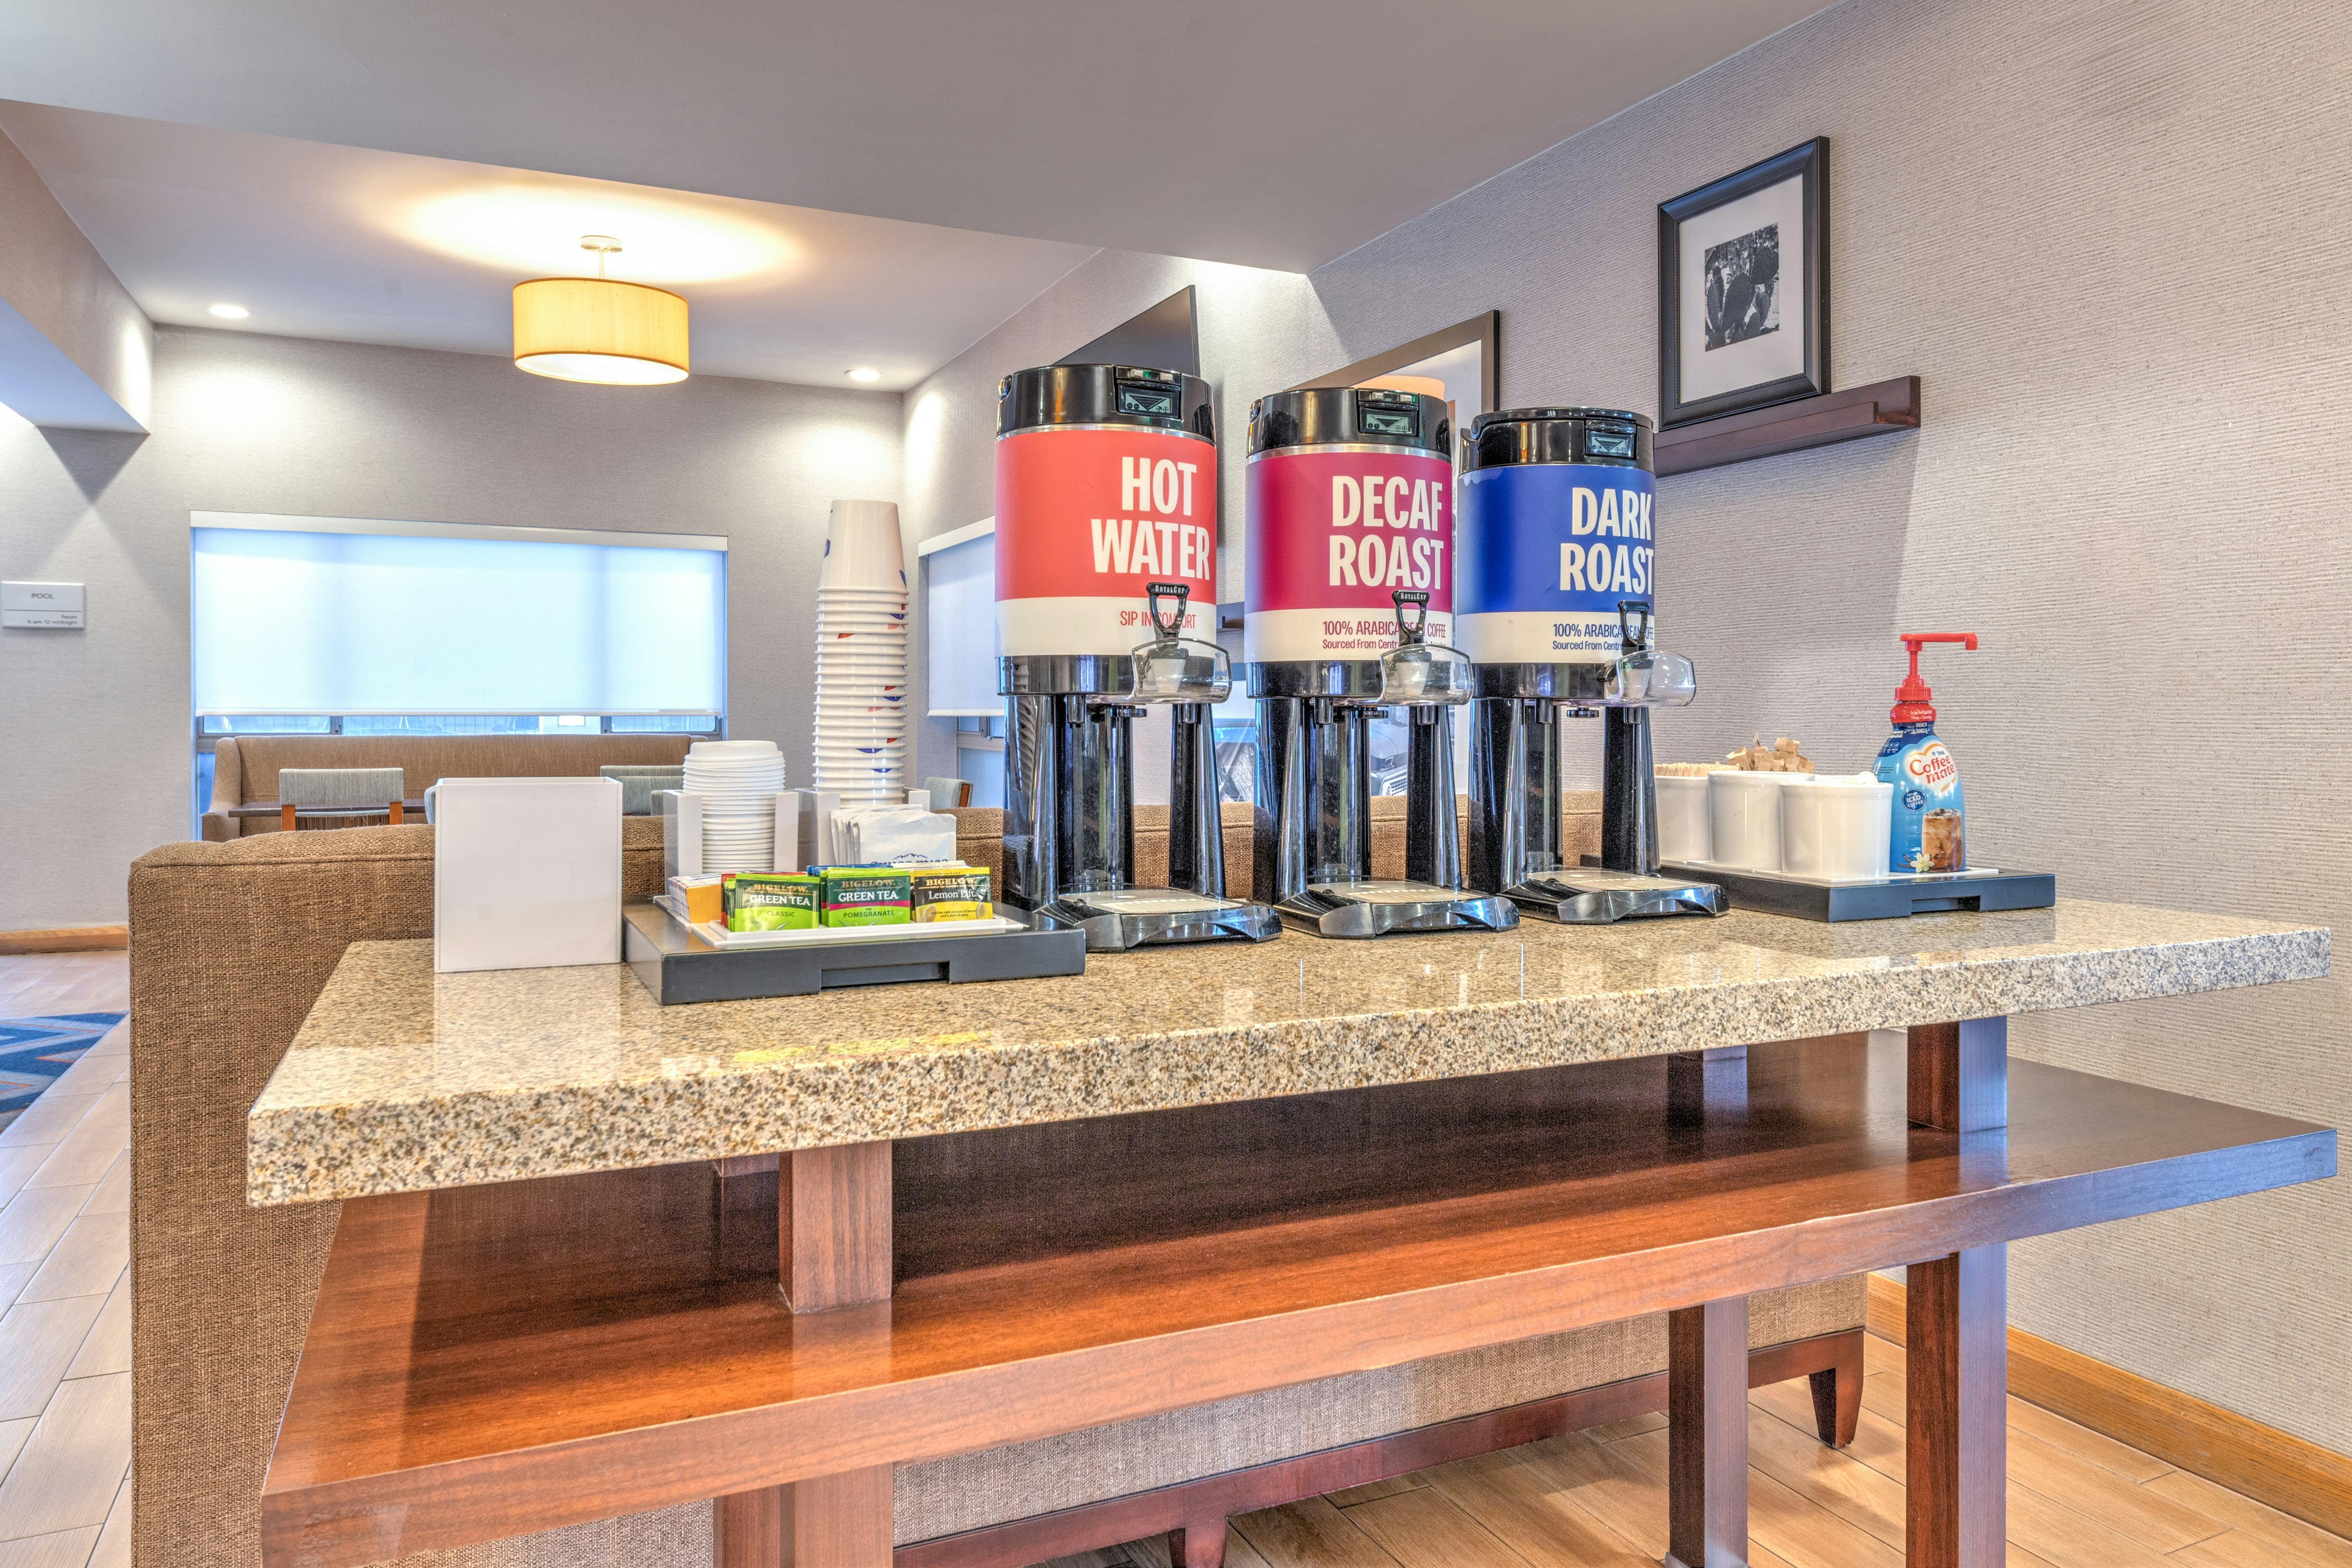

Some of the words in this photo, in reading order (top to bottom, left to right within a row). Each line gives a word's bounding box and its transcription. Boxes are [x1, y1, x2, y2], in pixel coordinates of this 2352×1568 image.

[1122, 456, 1197, 516] HOT
[1332, 475, 1443, 532] DECAF
[1572, 487, 1652, 541] DARK
[1091, 518, 1210, 581] WATER
[1329, 534, 1444, 590] ROAST
[1560, 543, 1655, 595] ROAST
[1120, 610, 1138, 626] SIP
[1142, 611, 1153, 627] IN
[1322, 620, 1354, 636] 100%
[1356, 620, 1400, 636] ARABICA
[1427, 622, 1446, 639] COFFEE
[1552, 623, 1582, 637] 100%
[1584, 624, 1622, 638] ARABICA
[1322, 639, 1356, 649] Sourced
[1357, 639, 1377, 649] From
[1378, 639, 1399, 650] Centr
[1552, 640, 1584, 650] Sourced
[1585, 640, 1602, 651] From
[1909, 755, 1951, 776] Coffee
[1925, 764, 1955, 784] mate
[1906, 794, 1922, 803] ICED
[1907, 800, 1924, 808] COFFEE
[749, 894, 787, 904] GREEN
[789, 895, 811, 906] TEA
[838, 891, 875, 902] GREEN
[876, 890, 899, 901] TEA
[928, 891, 959, 900] Lemon
[843, 910, 895, 918] POMEGRANATE
